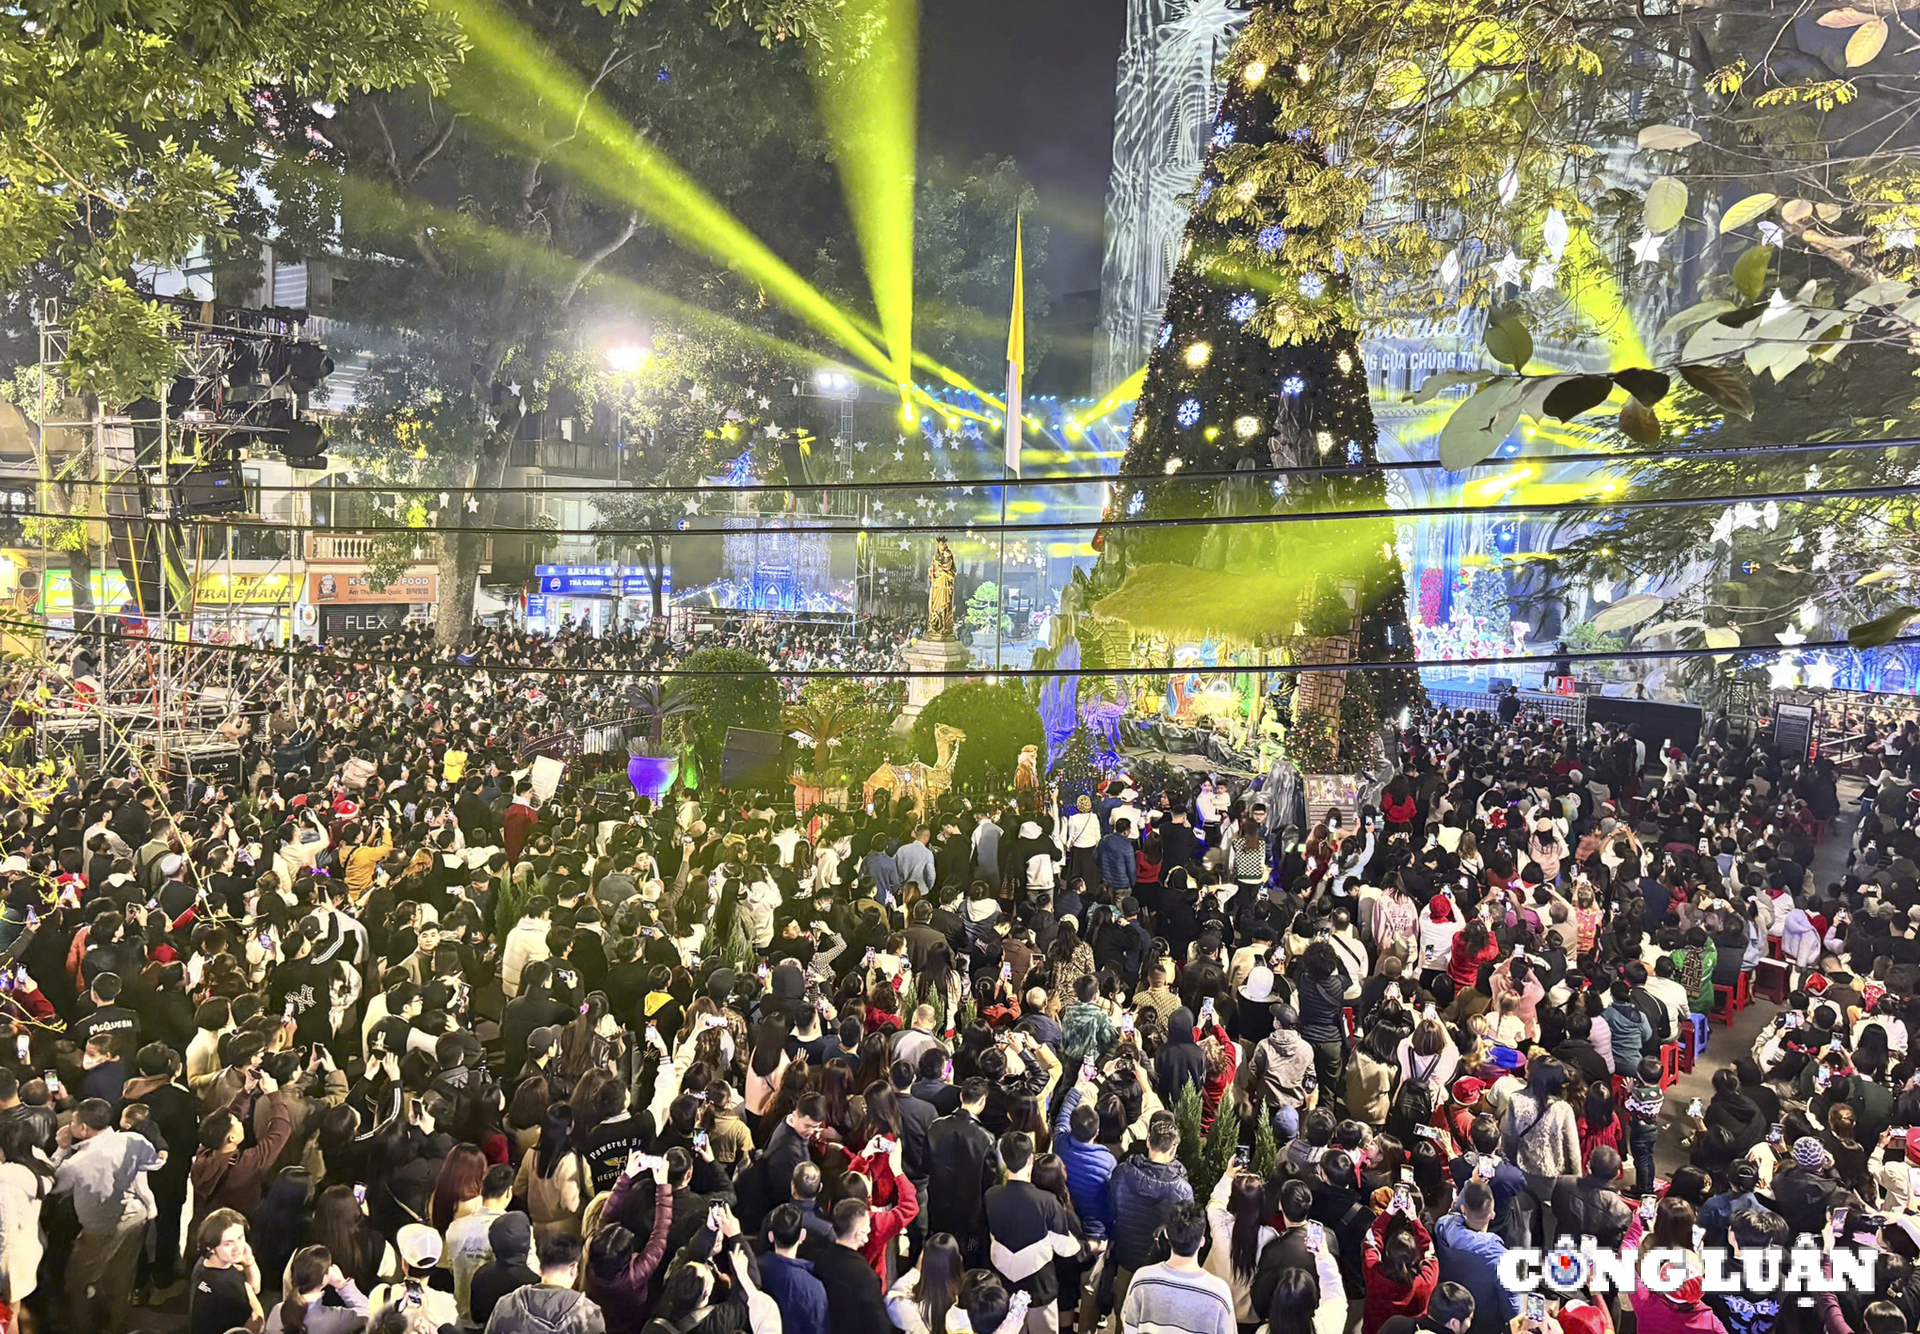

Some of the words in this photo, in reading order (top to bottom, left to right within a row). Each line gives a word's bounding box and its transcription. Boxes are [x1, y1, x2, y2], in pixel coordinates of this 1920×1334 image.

[1410, 350, 1456, 369] CHÚNG
[401, 577, 429, 586] FOOD
[345, 615, 388, 630] FLEX
[589, 1138, 627, 1160] Powered
